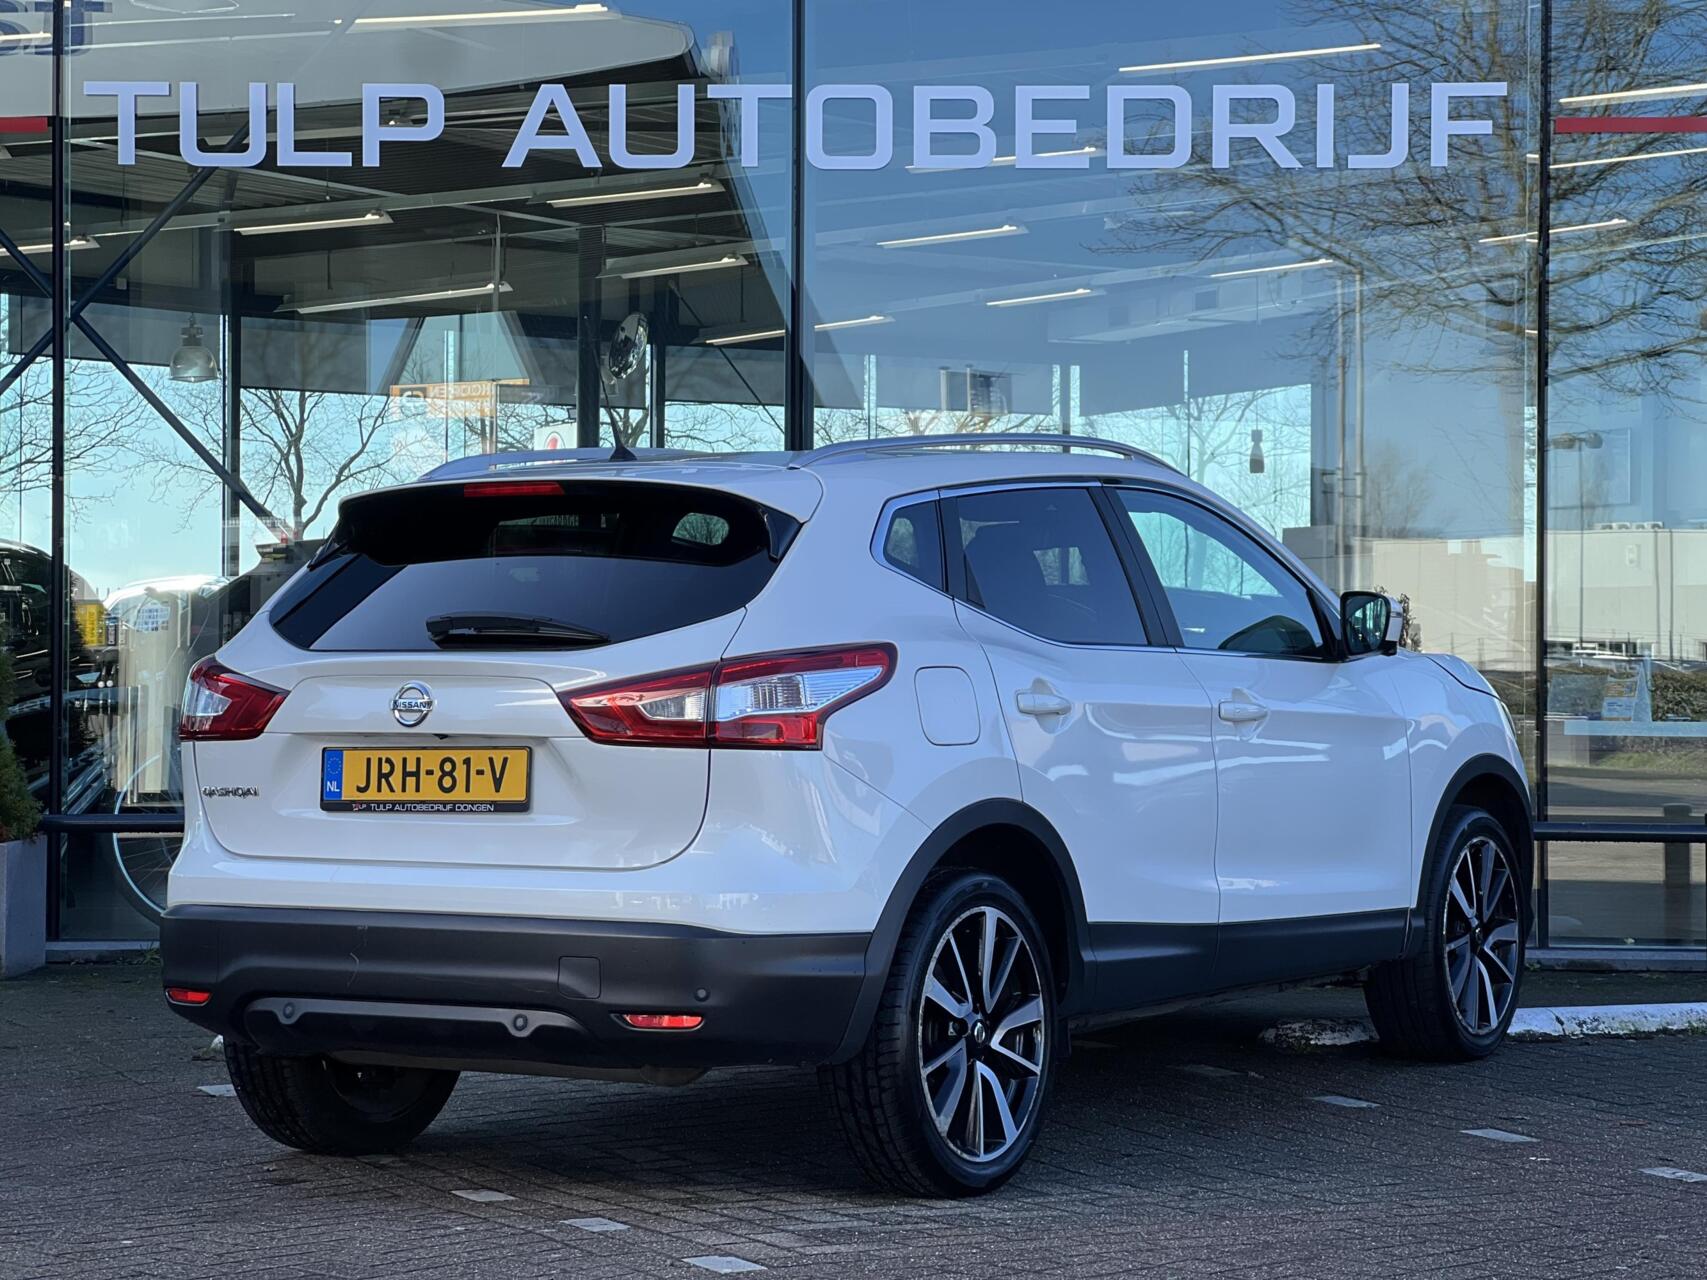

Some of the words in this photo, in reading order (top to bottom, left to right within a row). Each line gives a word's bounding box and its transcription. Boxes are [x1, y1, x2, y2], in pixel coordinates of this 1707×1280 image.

[83, 81, 446, 168] TULP
[502, 81, 1508, 170] AUTOBEDRIJF
[394, 701, 427, 709] NISSAN
[356, 756, 509, 794] JRH-81-V
[202, 786, 258, 798] QASHQAI
[326, 781, 340, 792] NL
[371, 803, 392, 811] TULP
[394, 804, 453, 812] AUTOBEDRIJF
[455, 804, 495, 812] DONGEN
